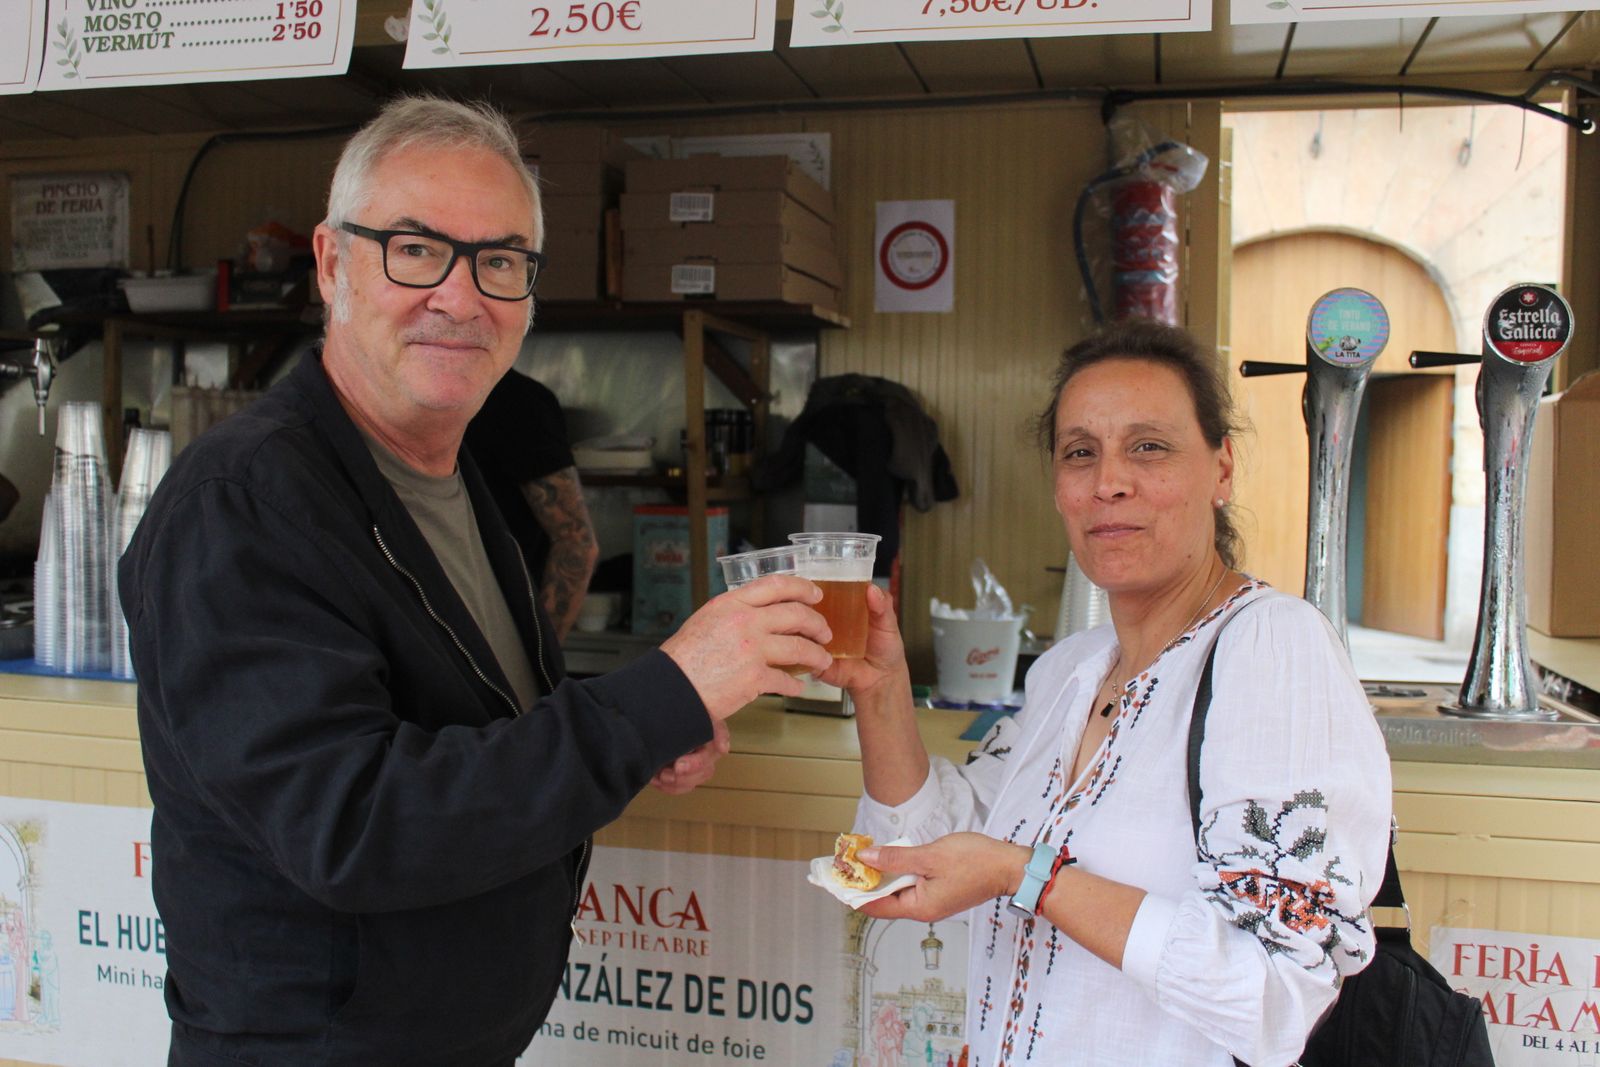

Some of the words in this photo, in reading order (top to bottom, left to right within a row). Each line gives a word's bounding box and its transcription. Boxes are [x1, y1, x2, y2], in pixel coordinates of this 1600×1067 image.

[84, 12, 162, 33] MOSTO
[275, 0, 323, 20] 1'50
[529, 0, 643, 38] 2,50€
[83, 29, 175, 53] VERMÚT
[271, 21, 322, 42] 2'50
[42, 182, 99, 198] PINCHO
[36, 201, 56, 215] DE
[62, 198, 103, 213] FERIA
[1498, 307, 1561, 324] Estrella
[1499, 323, 1558, 340] Galicia
[576, 881, 710, 932] ANCA
[78, 909, 109, 948] EL
[97, 964, 136, 987] Mini
[684, 973, 725, 1016] DE
[737, 978, 814, 1025] DIOS
[1454, 987, 1600, 1034] ALAM
[573, 1020, 600, 1042] de
[607, 1025, 679, 1051] micuit
[686, 1033, 714, 1055] de
[723, 1035, 766, 1060] foie
[1522, 1034, 1550, 1050] DEL
[1555, 1038, 1565, 1051] 4
[1569, 1039, 1590, 1053] AL
